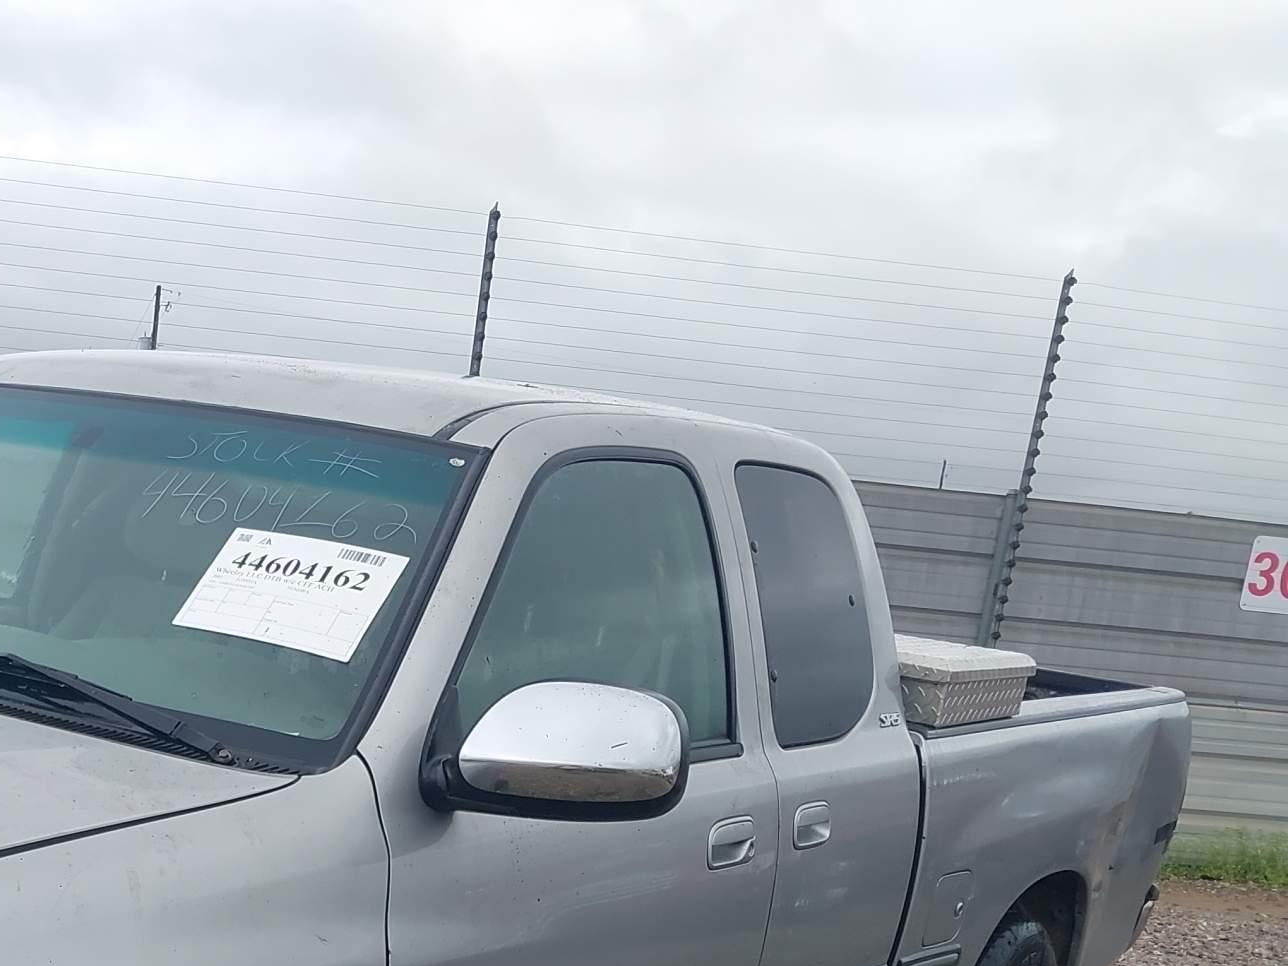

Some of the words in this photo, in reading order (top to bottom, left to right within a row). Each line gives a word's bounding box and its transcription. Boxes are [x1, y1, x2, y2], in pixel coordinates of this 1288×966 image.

[231, 551, 371, 592] 44604162
[1247, 551, 1288, 600] 3
[879, 712, 901, 728] SR5
